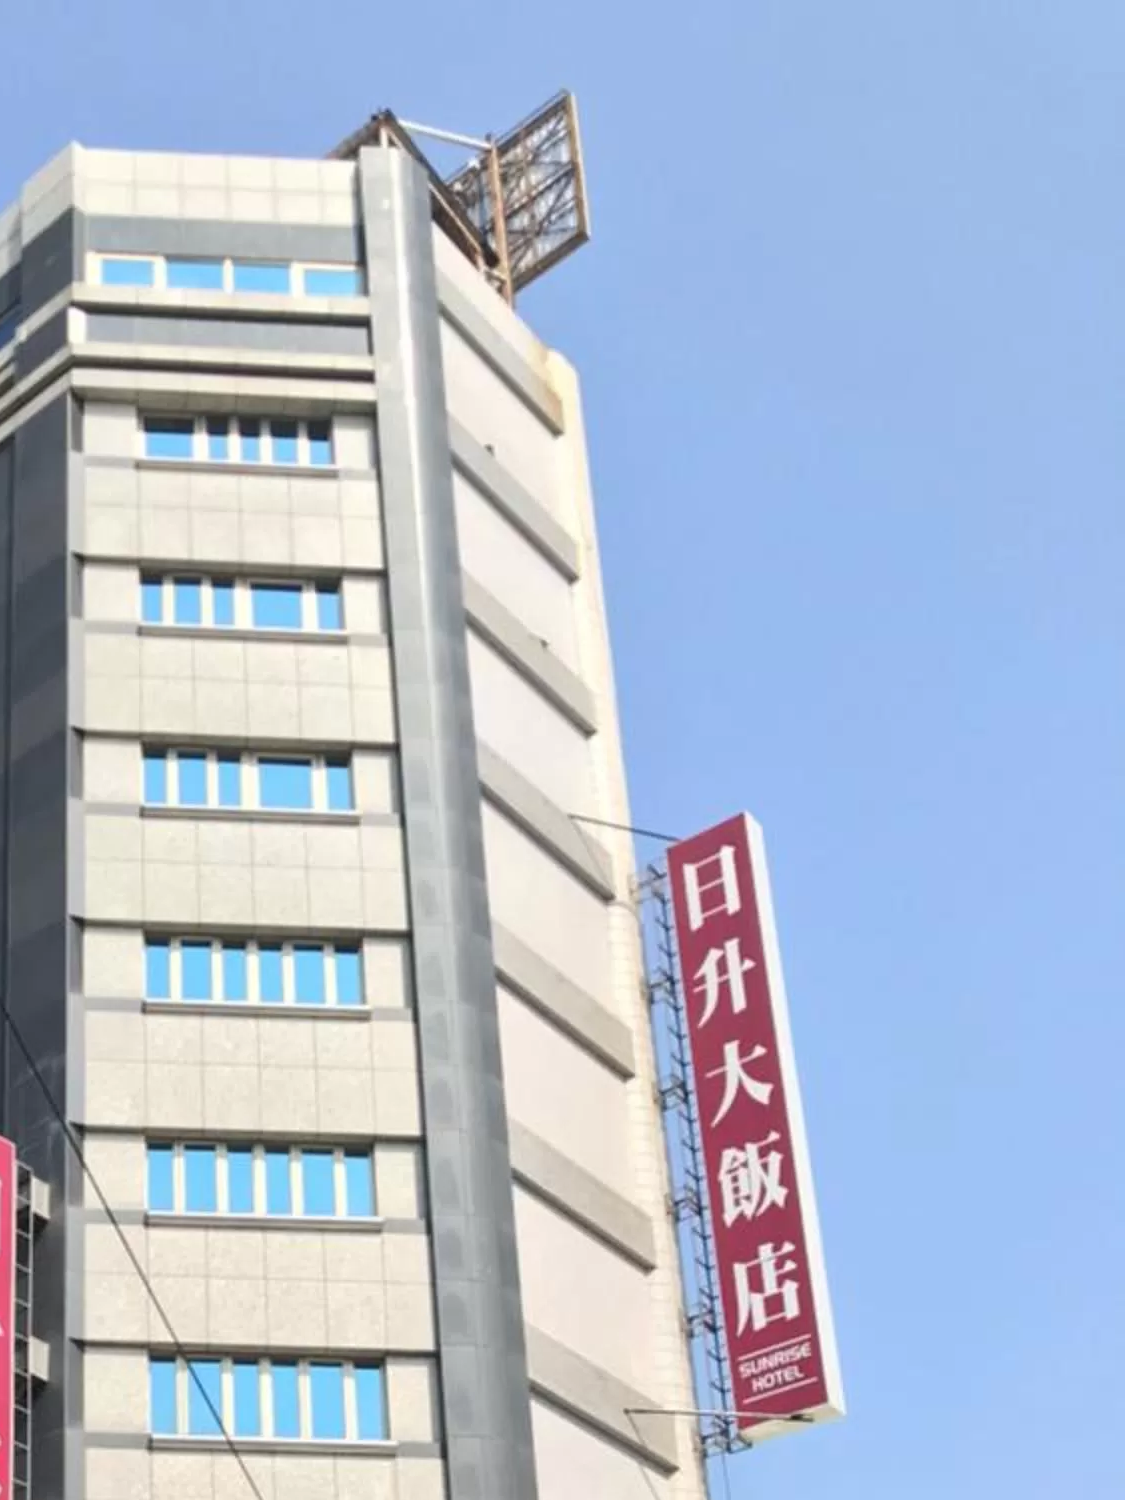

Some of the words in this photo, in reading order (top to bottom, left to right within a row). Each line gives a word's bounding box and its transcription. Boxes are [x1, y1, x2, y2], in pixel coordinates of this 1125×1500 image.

[683, 845, 802, 1338] 日升大飯店
[738, 1342, 812, 1379] SUNRISE
[751, 1364, 805, 1393] HOTEL
